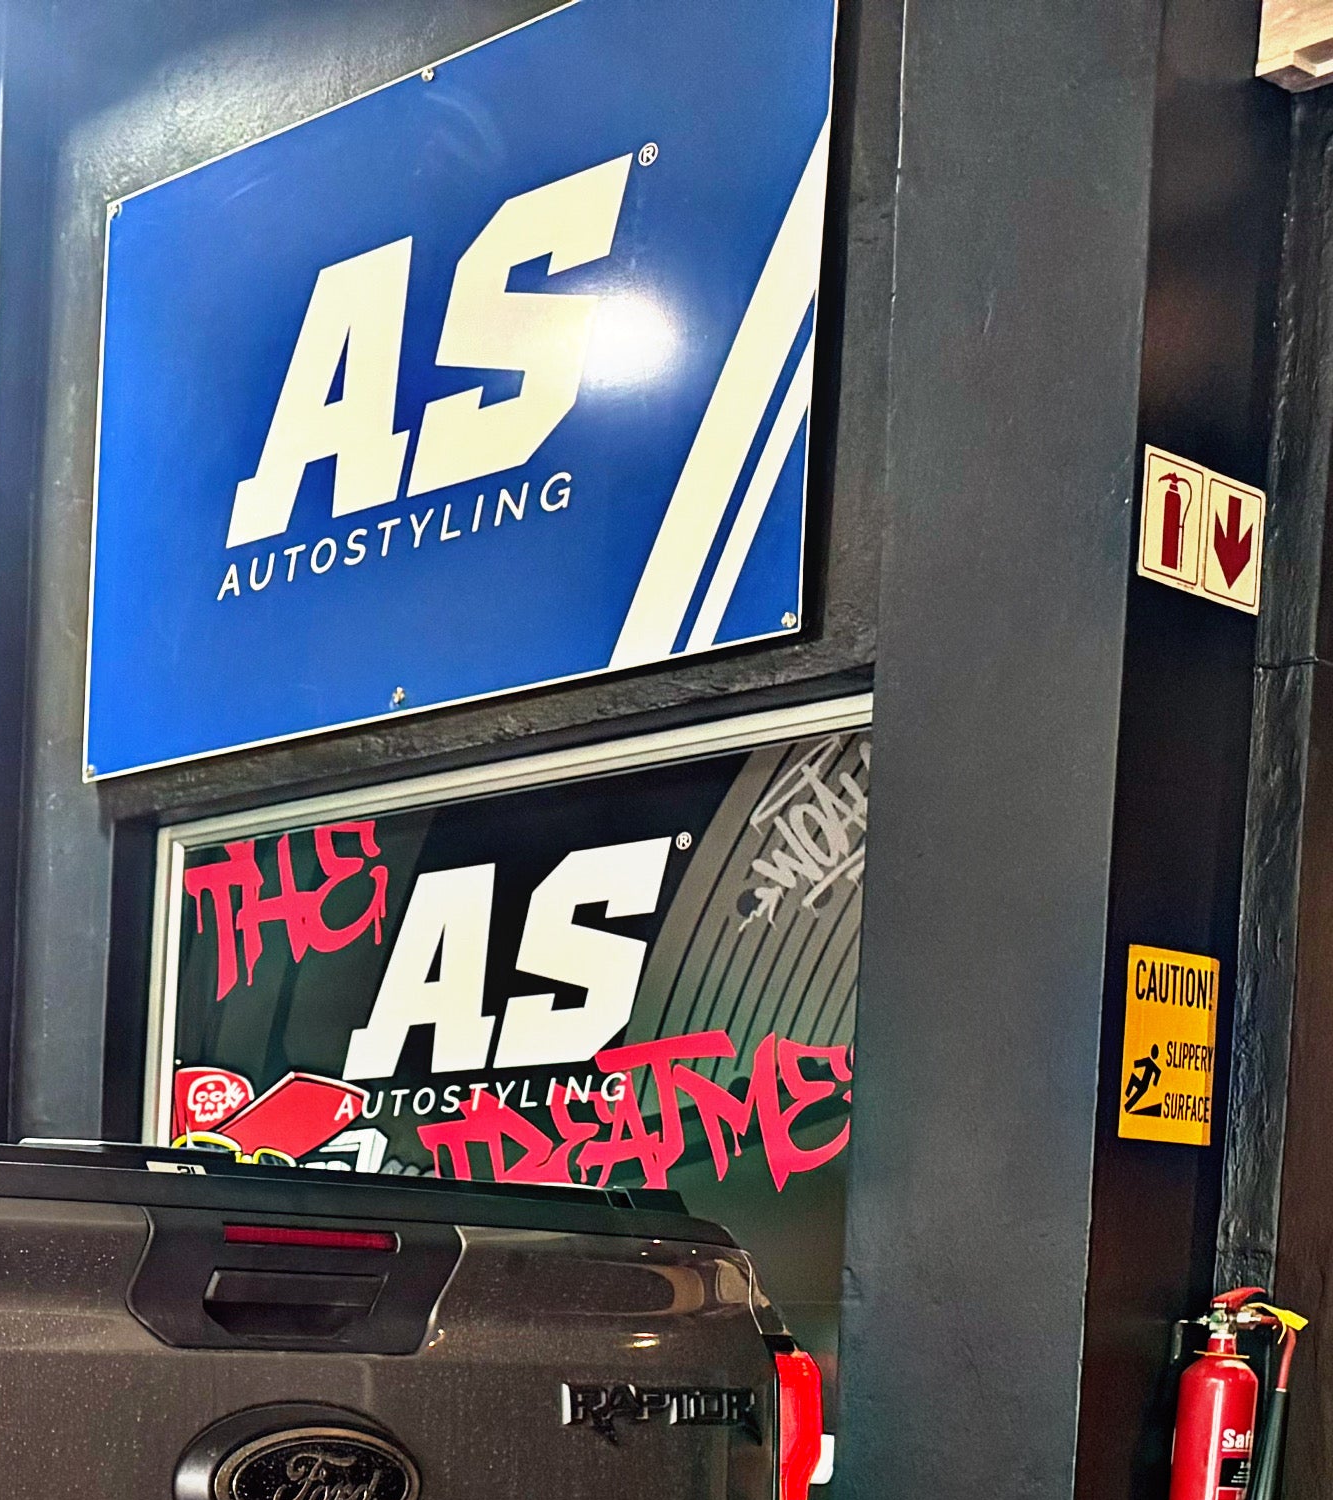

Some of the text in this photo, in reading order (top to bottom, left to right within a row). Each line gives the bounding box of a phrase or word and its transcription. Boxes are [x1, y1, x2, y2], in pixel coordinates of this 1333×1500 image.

[226, 152, 634, 549] AS
[217, 472, 572, 601] AUTOSTYLING
[342, 836, 673, 1081] AS
[1134, 958, 1215, 1012] CAUTION!
[1165, 1040, 1214, 1073] SLIPPERY
[334, 1072, 628, 1122] AUTOSTYLING
[1162, 1091, 1211, 1124] SURFACE
[561, 1382, 764, 1447] RAPTOR
